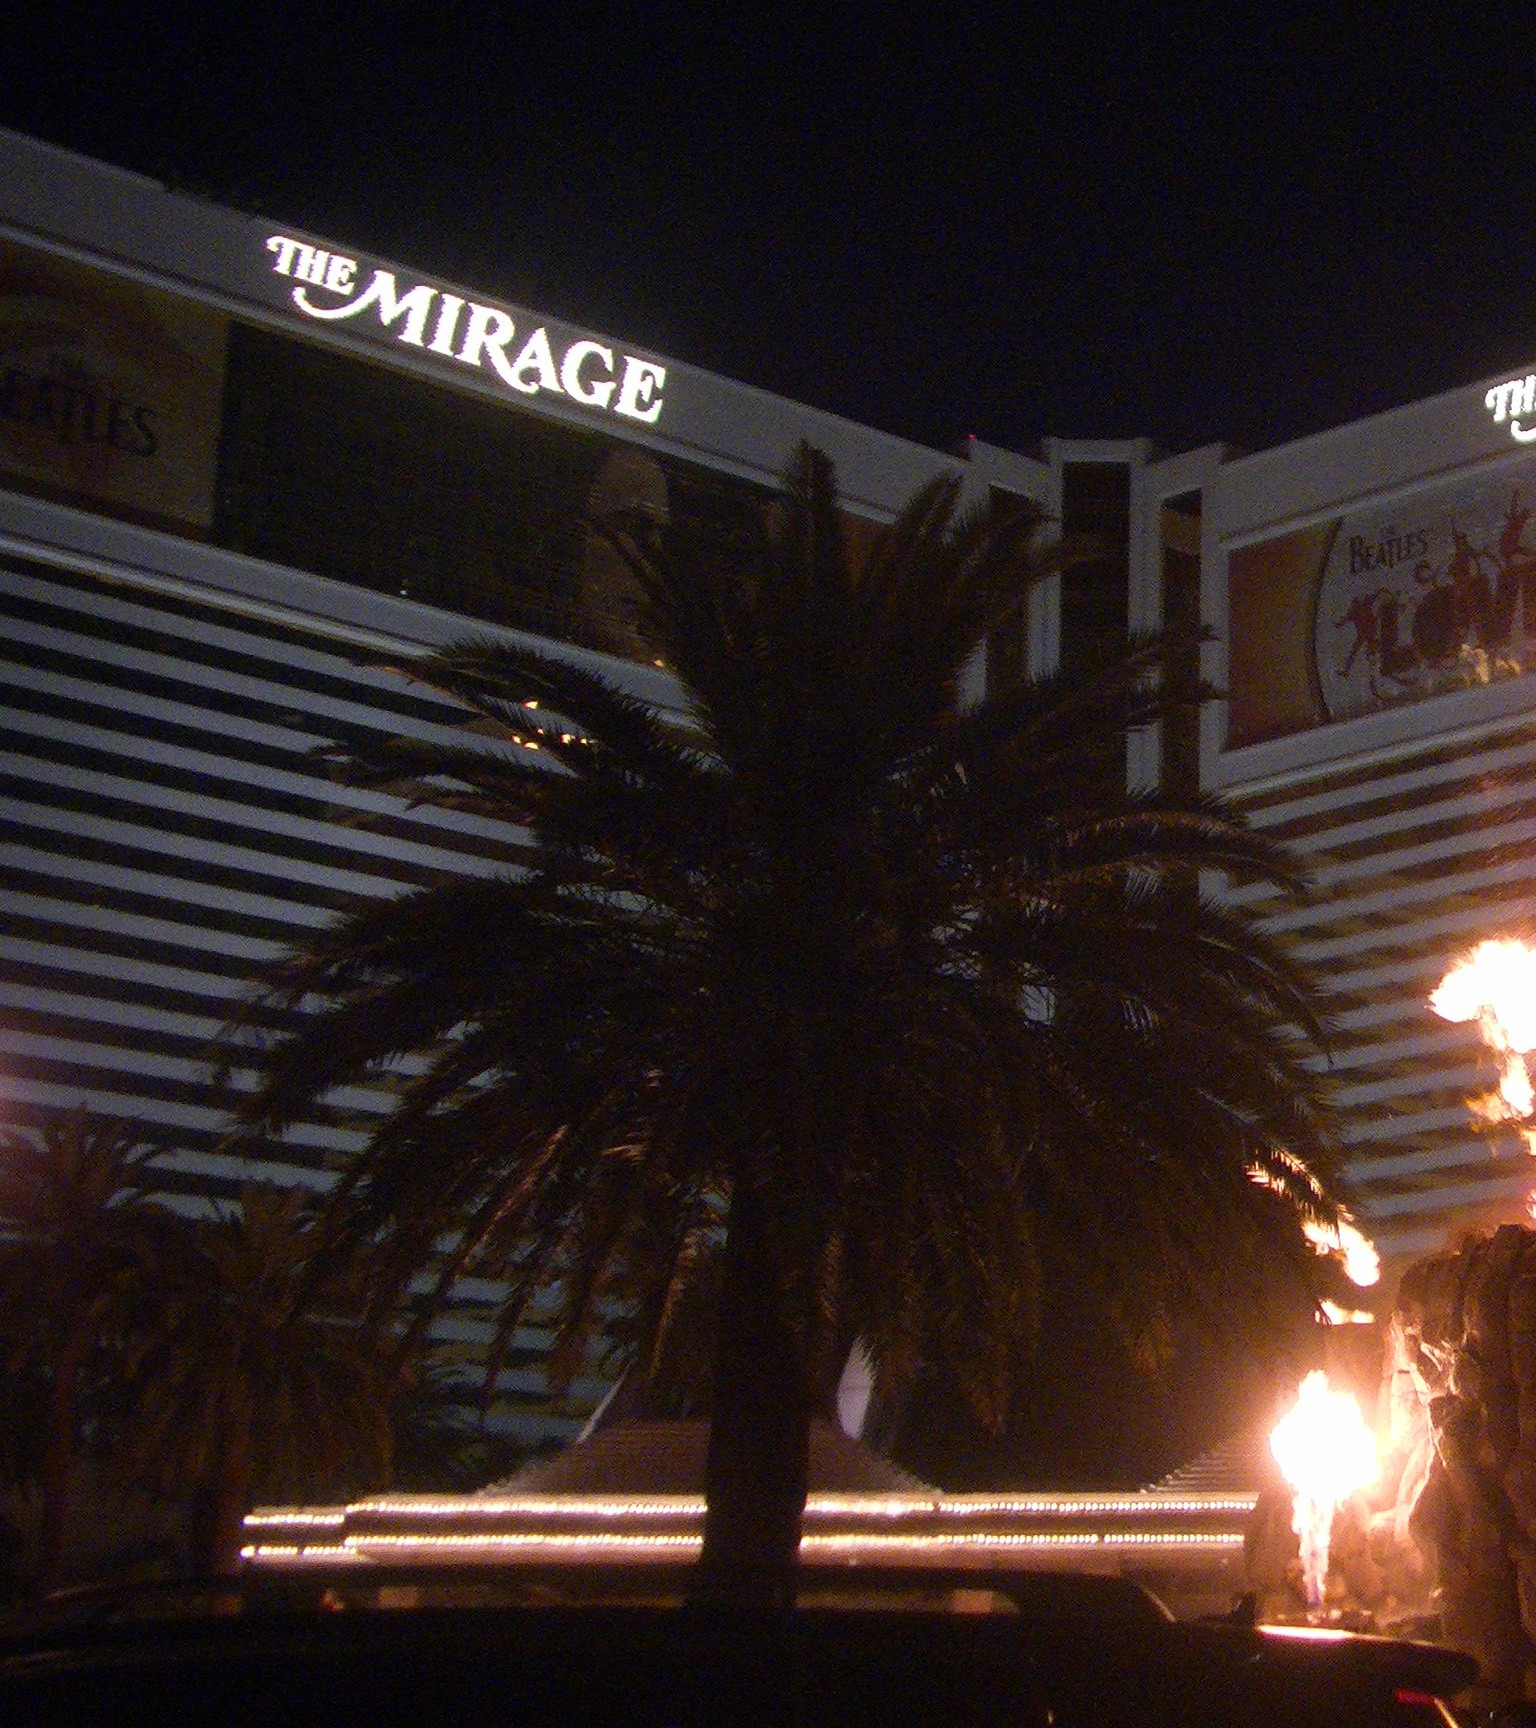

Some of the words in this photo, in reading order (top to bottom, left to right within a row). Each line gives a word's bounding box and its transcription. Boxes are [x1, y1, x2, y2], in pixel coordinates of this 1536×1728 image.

[267, 236, 358, 296] THE
[292, 269, 666, 424] MIRAGE
[0, 366, 165, 457] EATLES
[1349, 527, 1429, 574] BEATLES
